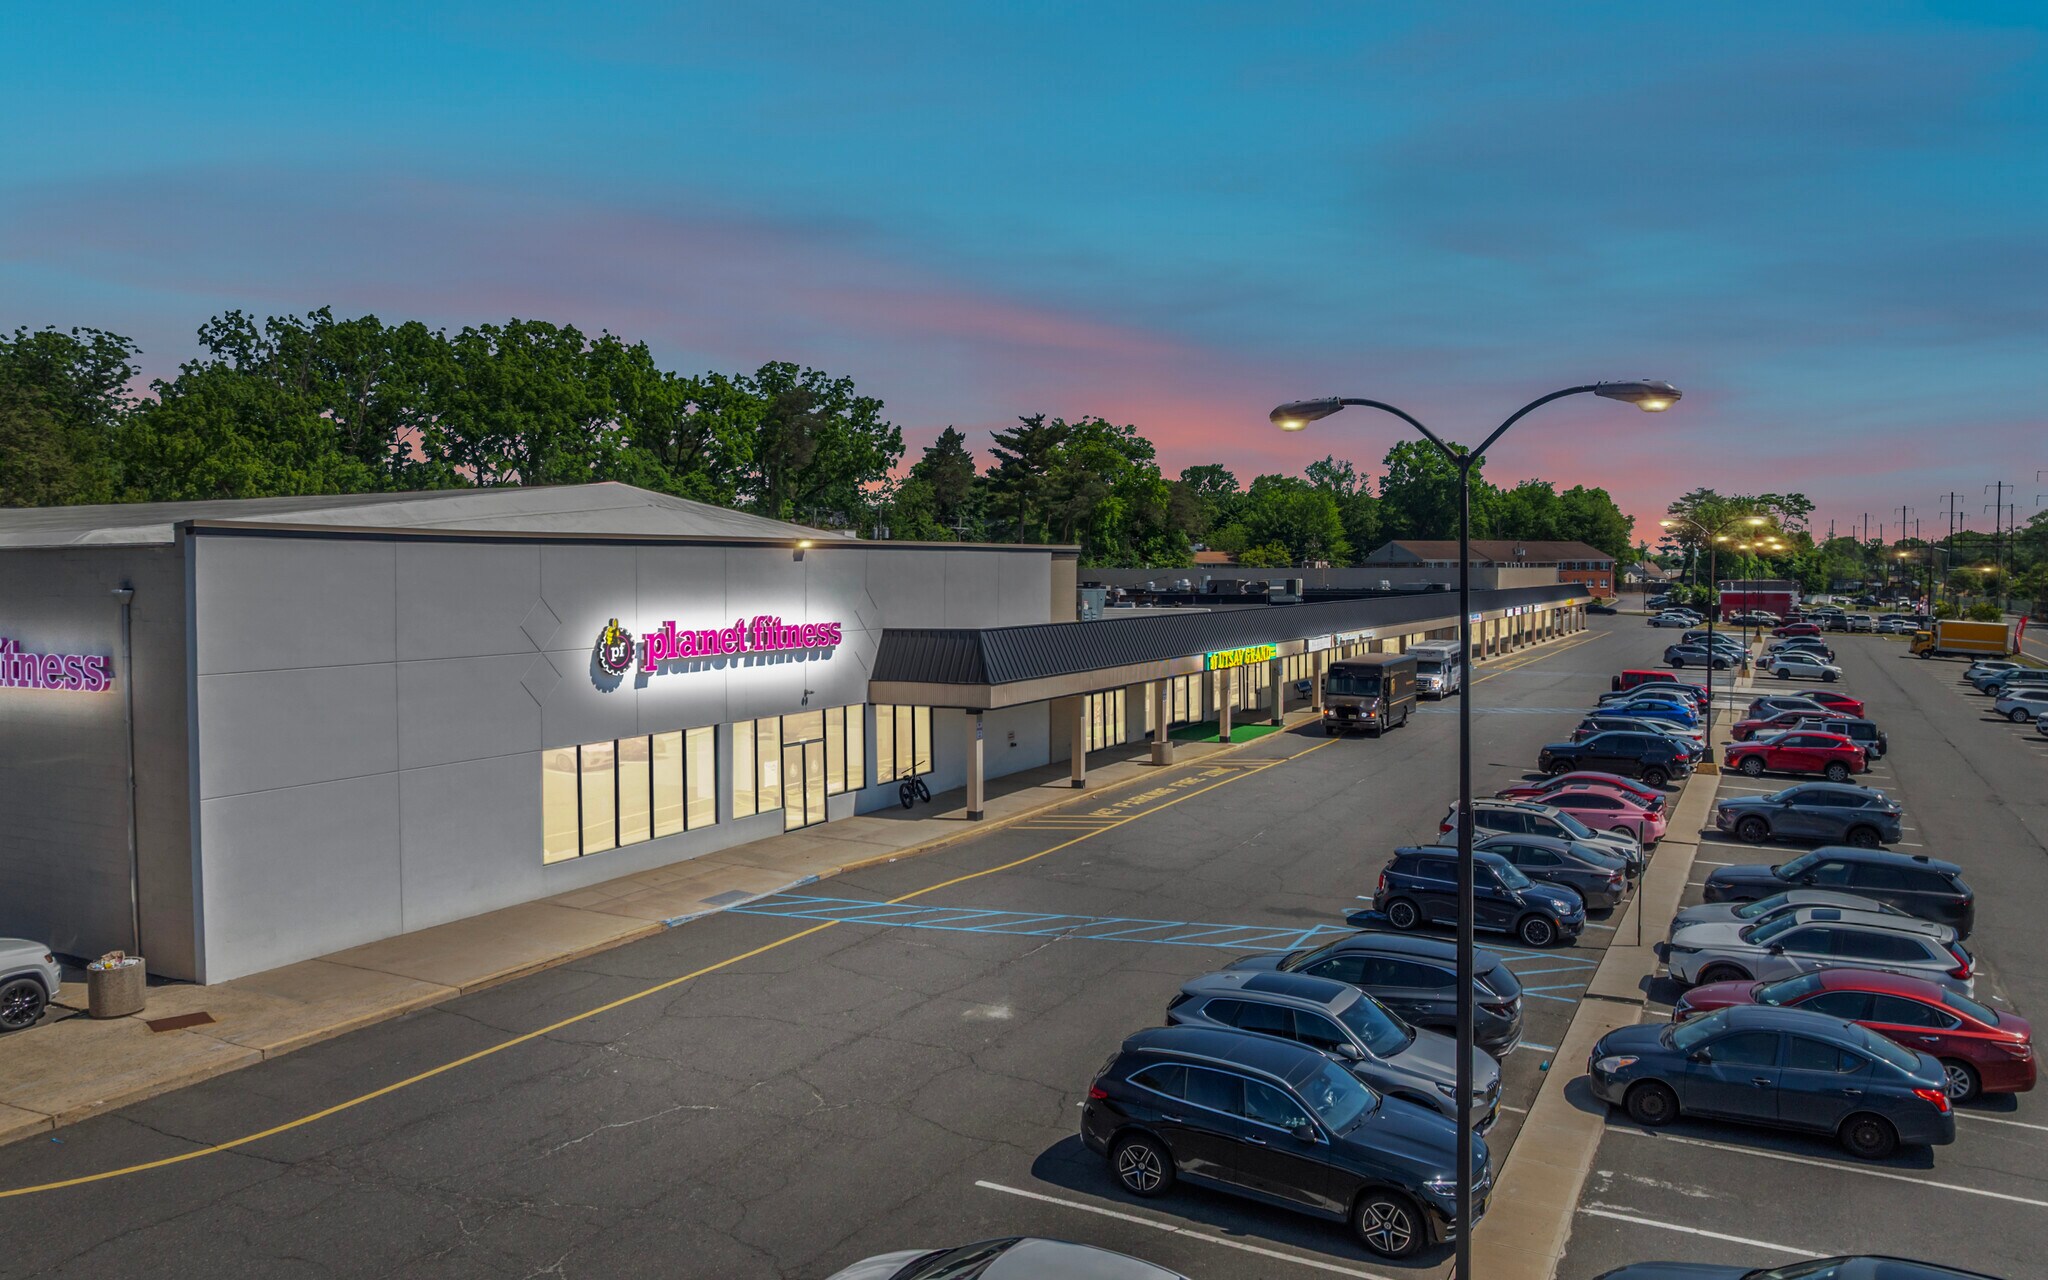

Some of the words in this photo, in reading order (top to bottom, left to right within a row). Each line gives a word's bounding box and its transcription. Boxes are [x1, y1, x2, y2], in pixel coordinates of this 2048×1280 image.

[610, 642, 626, 662] pf
[643, 620, 748, 673] planet
[752, 615, 842, 652] fitness
